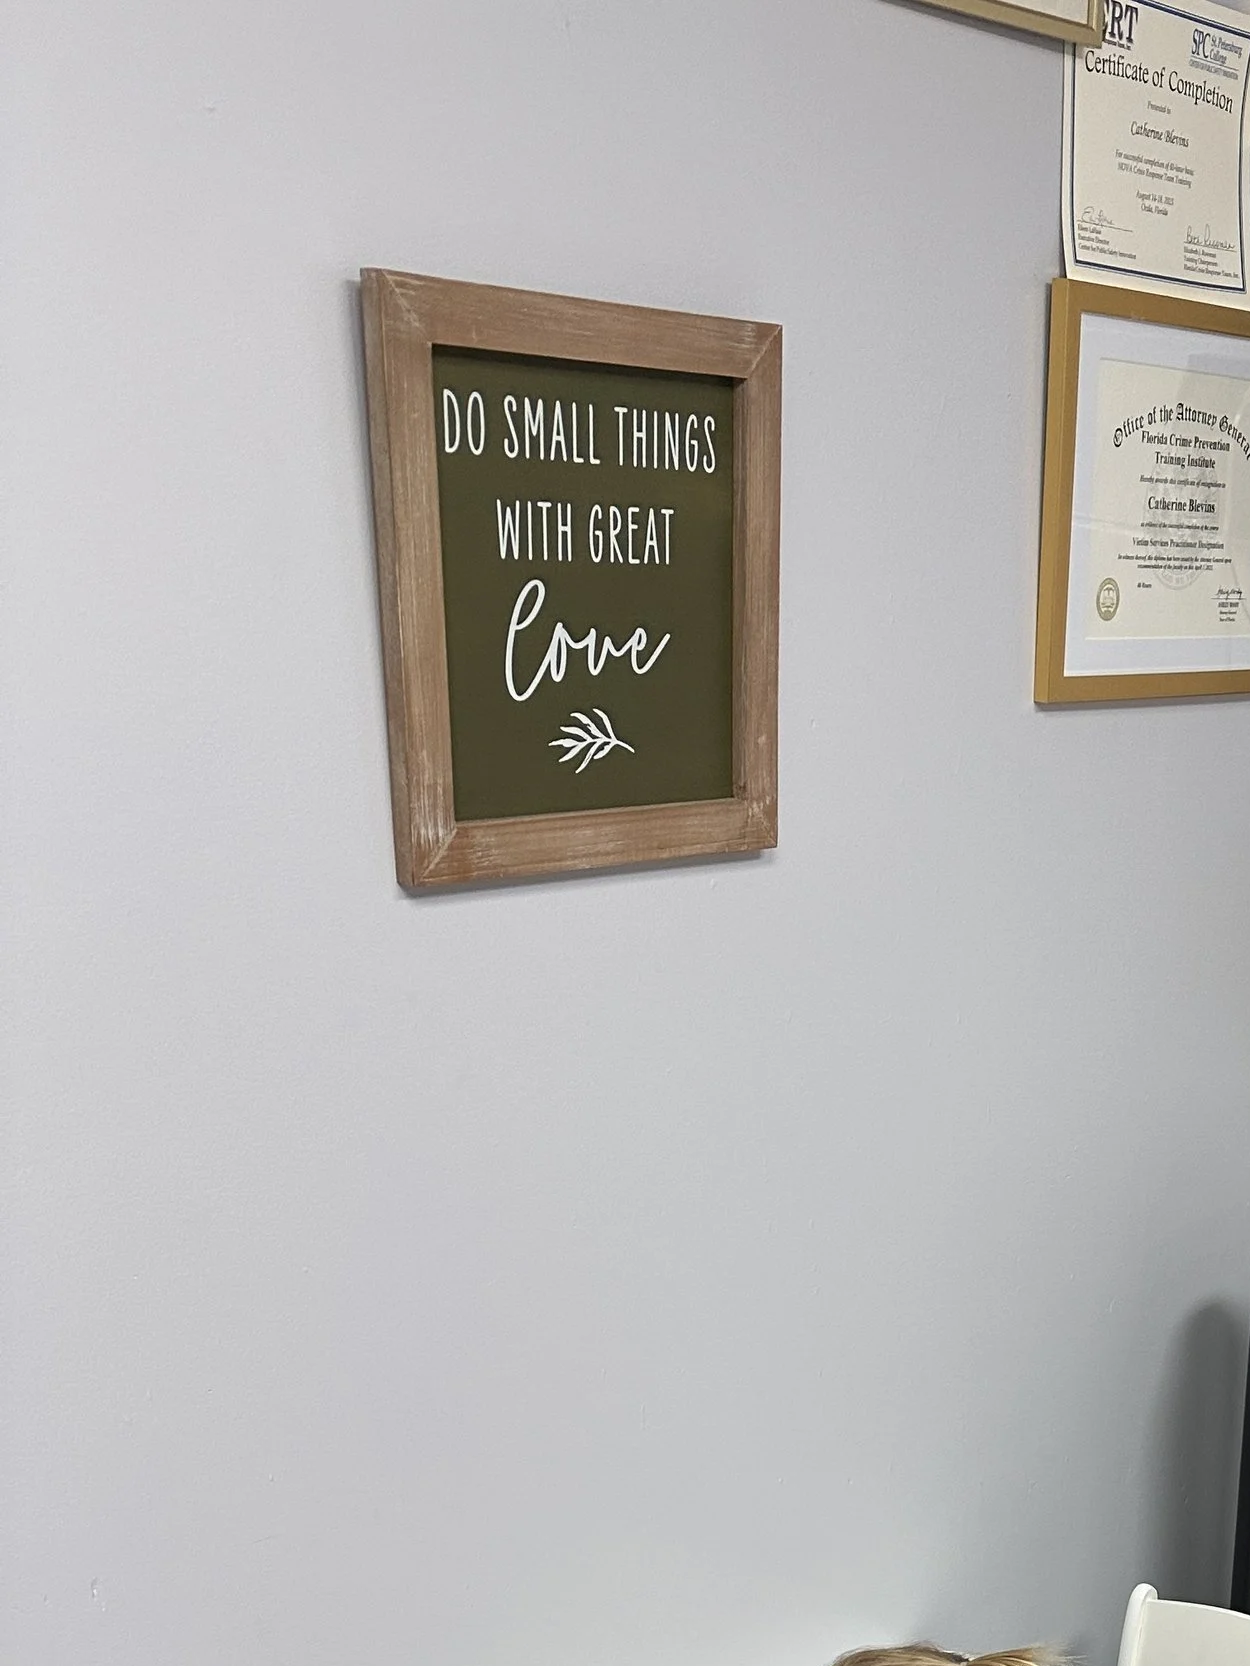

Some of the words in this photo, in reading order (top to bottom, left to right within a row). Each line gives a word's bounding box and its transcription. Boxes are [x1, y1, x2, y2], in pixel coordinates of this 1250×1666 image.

[1191, 28, 1211, 59] SPC
[1085, 50, 1149, 84] Certificate
[1152, 67, 1165, 88] of
[1168, 70, 1233, 114] Completion
[1131, 120, 1163, 141] Catherine
[1165, 128, 1190, 148] Blevins
[442, 388, 486, 456] DO
[503, 394, 600, 466] SMALL
[613, 406, 717, 474] THINGS
[1113, 414, 1144, 448] Office
[1147, 406, 1156, 424] of
[1160, 404, 1174, 424] the
[1176, 403, 1218, 431] Attorney
[1141, 430, 1168, 445] Florida
[1169, 433, 1192, 448] Crime
[1193, 436, 1231, 451] Prevention
[1155, 451, 1186, 469] Training
[1187, 454, 1216, 469] Institute
[1148, 495, 1187, 512] Catherine
[1188, 498, 1215, 513] Blevins
[496, 499, 573, 562] WITH
[588, 504, 675, 565] GREAT
[1133, 537, 1149, 546] Victim
[1150, 538, 1169, 547] Services
